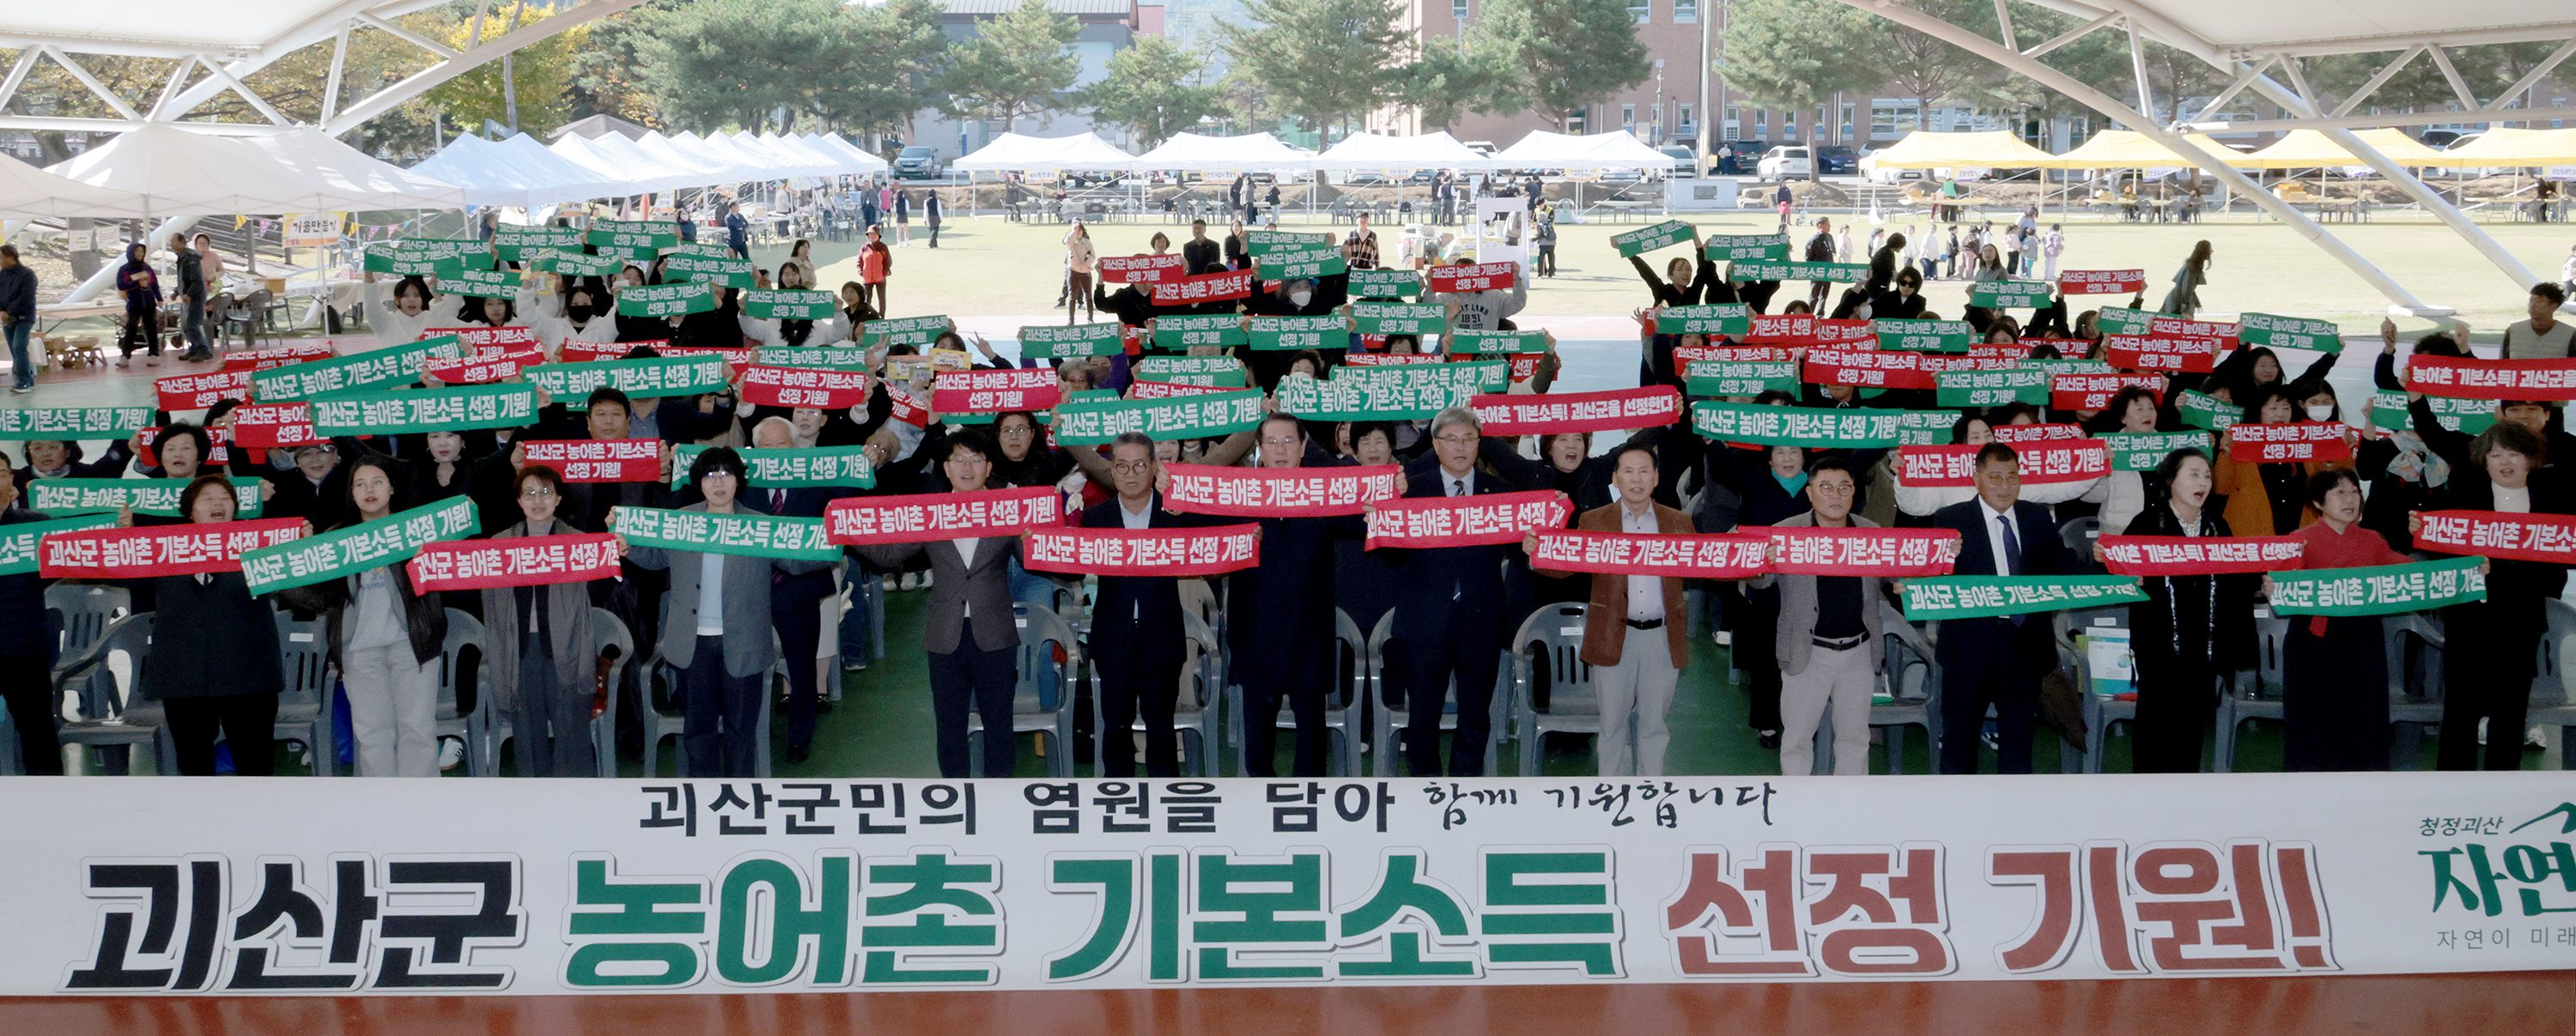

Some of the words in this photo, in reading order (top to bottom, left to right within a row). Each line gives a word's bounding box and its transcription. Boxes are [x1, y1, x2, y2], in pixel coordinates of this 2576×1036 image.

[617, 223, 641, 233] 농어촌
[643, 223, 676, 235] 기본소득
[614, 234, 631, 245] 선정
[633, 235, 652, 246] 기원!
[1103, 259, 1126, 270] 괴산군
[1127, 258, 1150, 270] 농어촌
[1151, 255, 1182, 268] 기본소득
[1432, 267, 1455, 278] 괴산군
[1456, 265, 1479, 277] 농어촌
[1481, 264, 1511, 276] 기본소득
[1126, 271, 1141, 282] 선정
[1143, 270, 1160, 281] 기원!
[1734, 264, 1759, 278] 괴산군
[1761, 265, 1789, 281] 농어촌
[1790, 267, 1825, 278] 기본소득
[2062, 270, 2086, 282] 괴산군
[2087, 272, 2111, 282] 농어촌
[2111, 269, 2144, 282] 기본소득
[620, 288, 647, 301] 괴산군
[648, 287, 675, 300] 농어촌
[677, 282, 709, 298] 기본소득
[1455, 279, 1471, 289] 선정
[1473, 277, 1490, 288] 기원!
[2087, 283, 2103, 293] 선정
[2104, 283, 2122, 292] 기원!
[647, 302, 665, 314] 선정
[666, 300, 687, 312] 기원!
[748, 291, 773, 303] 괴산군
[775, 292, 799, 304] 농어촌
[800, 291, 835, 304] 기본소득
[772, 306, 789, 317] 선정
[791, 306, 809, 317] 기원!
[1250, 318, 1279, 331] 괴산군
[1280, 318, 1309, 331] 농어촌
[1310, 316, 1348, 330] 기본소득
[2241, 315, 2270, 330] 괴산군
[2272, 318, 2301, 333] 농어촌
[1279, 333, 1297, 346] 선정
[1299, 333, 1320, 345] 기원!
[2111, 337, 2138, 350] 괴산군
[2142, 338, 2171, 352] 농어촌
[2172, 341, 2213, 354] 기본소득
[2269, 332, 2289, 346] 선정
[2291, 335, 2313, 348] 기원!
[2138, 354, 2158, 367] 선정
[2160, 355, 2182, 368] 기원!
[935, 374, 970, 390] 괴산군
[972, 373, 1008, 389] 농어촌
[1012, 371, 1058, 388] 기본소득
[2413, 367, 2453, 385] 농어촌
[2458, 368, 2517, 387] 기본소득!
[2519, 370, 2576, 388] 괴산군을
[315, 402, 360, 427] 괴산군
[361, 399, 405, 426] 농어촌
[408, 397, 465, 423] 기본소득
[468, 395, 496, 421] 선정
[499, 391, 531, 418] 기원!
[969, 392, 993, 408] 선정
[996, 391, 1023, 407] 기원!
[1060, 412, 1099, 436] 괴산군
[1103, 409, 1143, 435] 농어촌
[1145, 404, 1198, 432] 기본소득
[1202, 400, 1228, 427] 선정
[1231, 397, 1262, 422] 기원!
[1472, 405, 1510, 424] 농어촌
[1513, 404, 1568, 422] 기본소득!
[1571, 400, 1620, 420] 괴산군을
[1624, 395, 1673, 416] 선정한다
[24, 409, 81, 432] 기본소득
[85, 409, 112, 431] 선정
[115, 409, 148, 431] 기원!
[1698, 409, 1735, 434] 괴산군
[1740, 411, 1778, 437] 농어촌
[1783, 414, 1835, 439] 기본소득
[1839, 415, 1866, 439] 선정
[1869, 415, 1901, 439] 기원!
[526, 444, 565, 459] 괴산군
[567, 443, 605, 459] 농어촌
[607, 442, 657, 458] 기본소득
[565, 463, 590, 478] 선정
[592, 462, 621, 478] 기원!
[1171, 476, 1213, 503] 괴산군
[1218, 477, 1261, 506] 농어촌
[1266, 479, 1324, 506] 기본소득
[1329, 477, 1357, 505] 선정
[1361, 474, 1394, 503] 기원!
[831, 508, 877, 535] 괴산군
[880, 506, 924, 533] 농어촌
[927, 502, 986, 529] 기본소득
[990, 500, 1019, 526] 선정
[1023, 496, 1055, 524] 기원!
[1408, 508, 1451, 536] 농어촌
[1455, 505, 1513, 534] 기본소득
[1517, 502, 1546, 530] 선정
[614, 506, 659, 539] 괴산군
[662, 512, 707, 542] 농어촌
[710, 518, 770, 548] 기본소득
[773, 523, 805, 549] 선정
[2421, 516, 2469, 544] 괴산군
[2472, 520, 2520, 548] 농어촌
[288, 544, 338, 577] 농어촌
[342, 525, 404, 565] 기본소득
[405, 514, 437, 550] 선정
[439, 499, 474, 536] 기원!
[47, 540, 98, 566] 괴산군
[102, 537, 152, 566] 농어촌
[156, 533, 222, 563] 기본소득
[227, 531, 258, 562] 선정
[1032, 534, 1075, 562] 괴산군
[1079, 537, 1122, 565] 농어촌
[1127, 538, 1185, 566] 기본소득
[1189, 536, 1218, 564] 선정
[1222, 534, 1252, 561] 기원!
[1538, 536, 1583, 561] 괴산군
[1586, 537, 1631, 564] 농어촌
[1634, 540, 1695, 566] 기본소득
[1698, 542, 1729, 567] 선정
[1731, 542, 1770, 567] 기원!
[1790, 536, 1833, 564] 농어촌
[1838, 537, 1895, 566] 기본소득
[1900, 539, 1929, 566] 선정
[2142, 545, 2205, 562] 기본소득!
[2207, 543, 2258, 561] 괴산군을
[1910, 585, 1956, 609] 괴산군
[1957, 585, 2003, 608] 농어촌
[2004, 585, 2063, 604] 기본소득
[2318, 578, 2364, 606] 농어촌
[2366, 573, 2425, 603] 기본소득
[2429, 570, 2457, 599] 선정
[639, 783, 976, 837] 괴산군민의
[1024, 782, 1222, 834] 염원을
[1266, 782, 1394, 833] 담아
[1422, 779, 1517, 830] 함께
[1545, 780, 1777, 829] 기원합니다
[2419, 816, 2505, 837] 청정괴산
[65, 861, 518, 989] 괴산군
[566, 855, 996, 986] 농어촌
[1048, 852, 1616, 980] 기본소득
[1668, 848, 1947, 975] 선정
[1991, 845, 2332, 971] 기원!
[2437, 927, 2510, 950] 자연이
[2530, 926, 2576, 948] 미래
